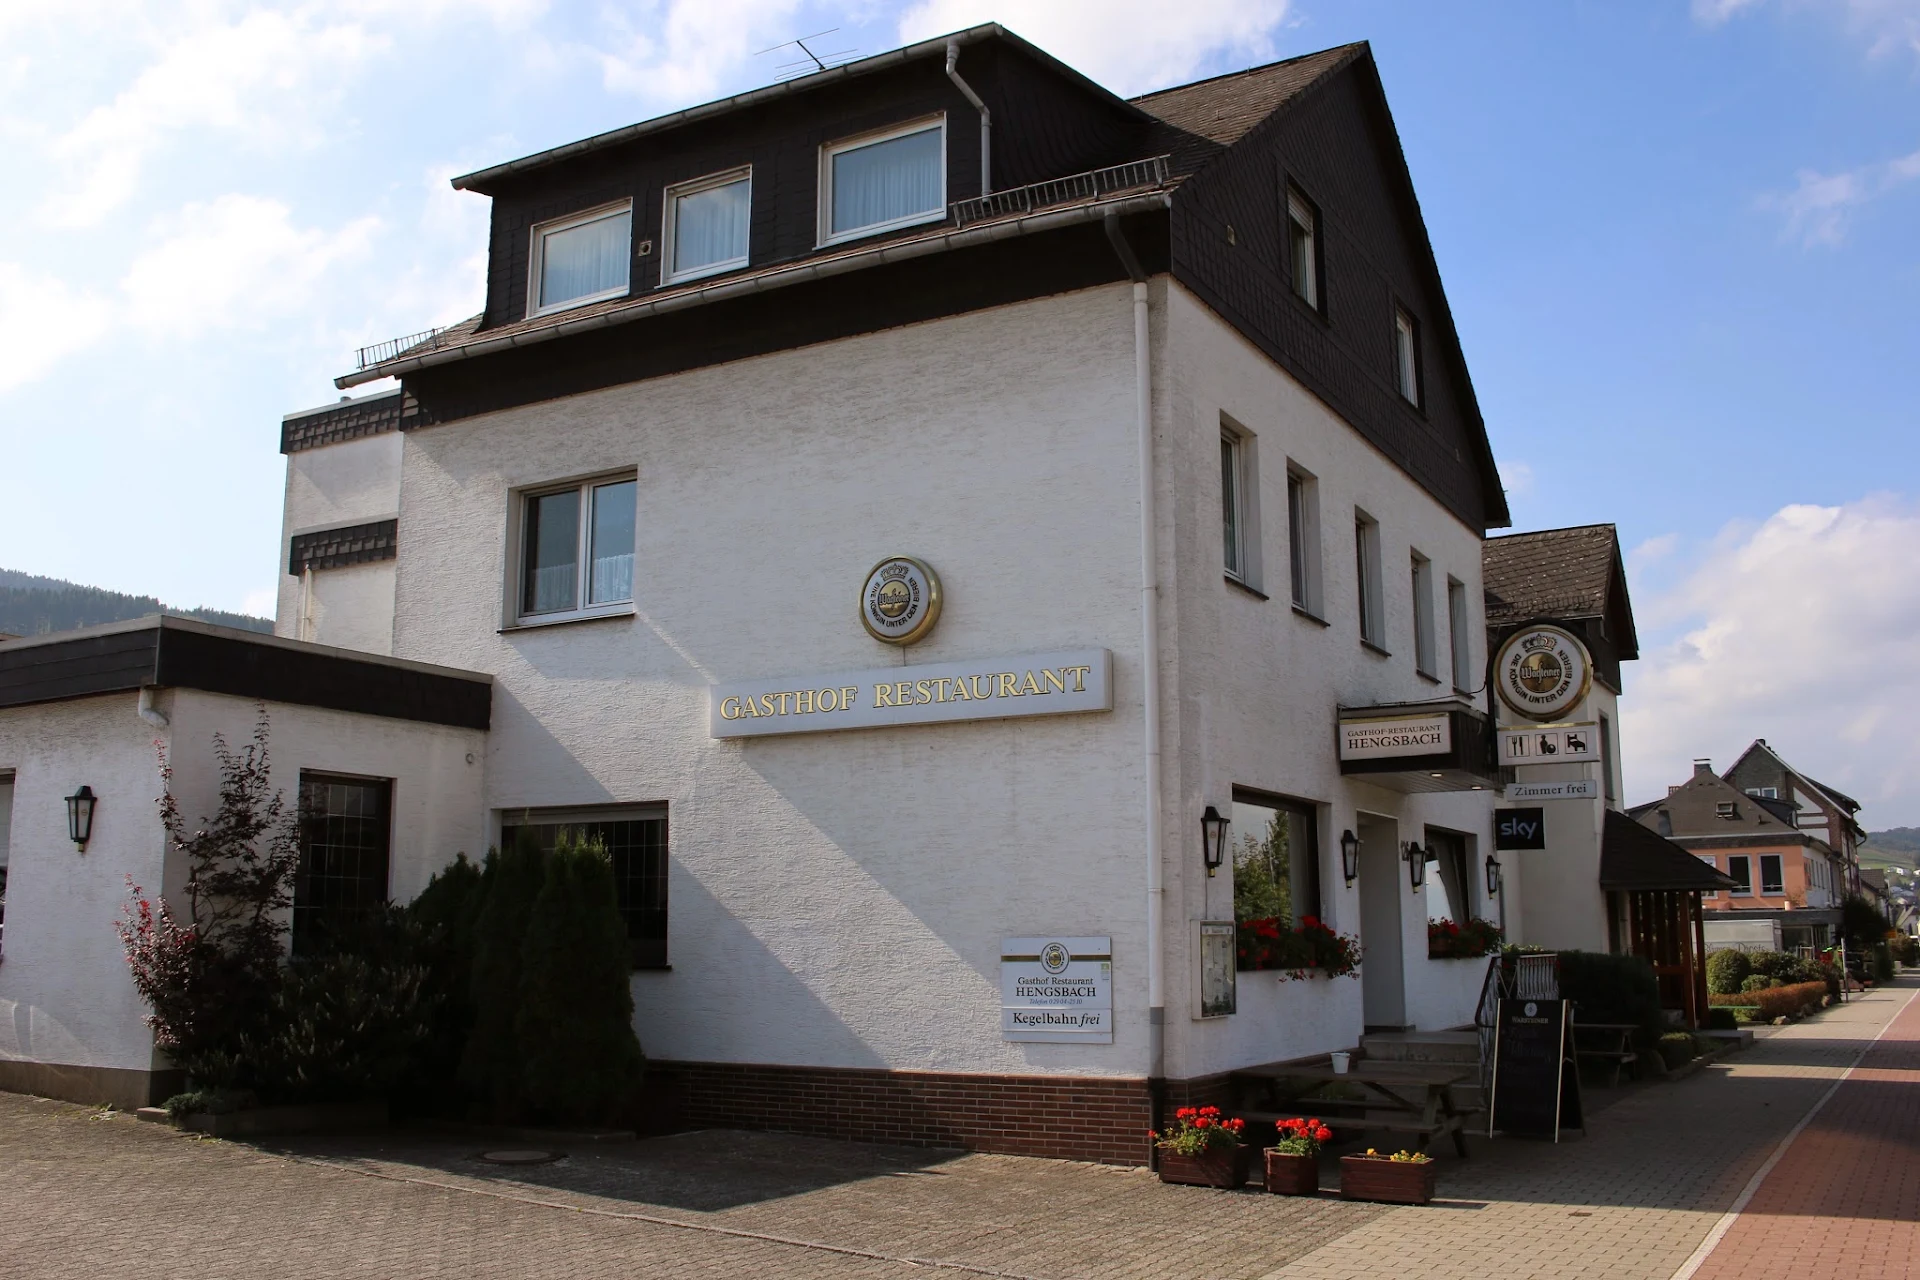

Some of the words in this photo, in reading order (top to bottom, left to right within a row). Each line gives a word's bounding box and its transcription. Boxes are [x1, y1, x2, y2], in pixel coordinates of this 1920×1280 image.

[909, 577, 920, 602] BIEREN
[907, 603, 918, 619] DEN
[886, 617, 908, 628] UNTER
[1510, 653, 1522, 667] DIE
[1558, 649, 1573, 679] BIEREN
[1521, 661, 1561, 684] Warsteiner
[1509, 668, 1529, 700] KÖNIGIN
[1556, 680, 1571, 697] DEN
[719, 686, 858, 720] GASTHOF
[873, 666, 1091, 708] RESTAURANT
[1528, 693, 1557, 704] UNTER
[1348, 733, 1442, 749] HENGSBACH
[1515, 786, 1562, 796] Zimmer
[1566, 783, 1587, 794] frei
[1500, 817, 1537, 840] sky
[1017, 976, 1049, 985] Gasthof
[1051, 976, 1094, 985] Restaurant
[1015, 986, 1097, 997] HENGSBACH
[1013, 1012, 1077, 1027] Kegelbahn
[1078, 1013, 1101, 1028] frei
[1511, 1016, 1550, 1025] WARSTEINER
